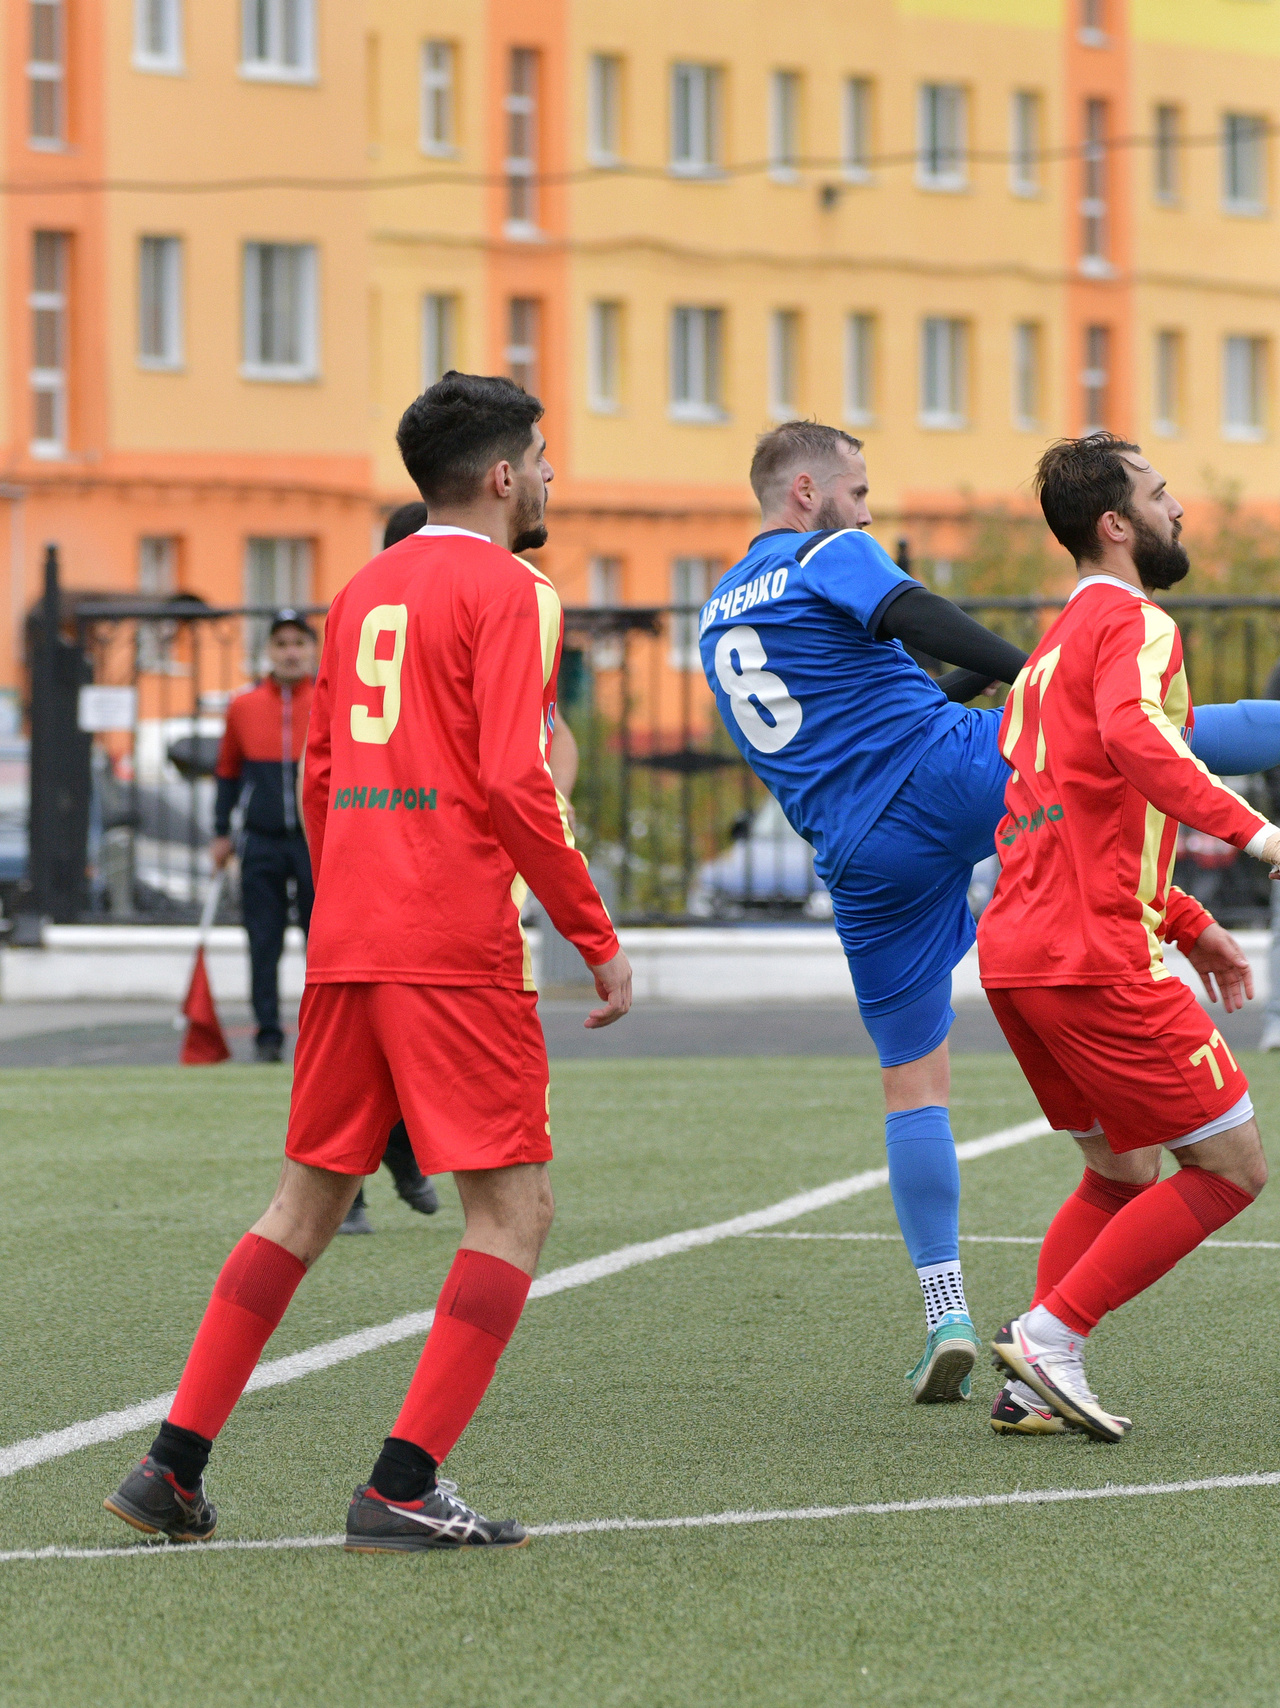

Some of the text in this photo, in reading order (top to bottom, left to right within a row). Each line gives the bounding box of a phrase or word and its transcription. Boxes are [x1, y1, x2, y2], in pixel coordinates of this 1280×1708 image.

[351, 604, 408, 744] 9
[715, 625, 803, 753] 8
[333, 786, 437, 810] ЮНИРОН
[1188, 1028, 1238, 1090] 77
